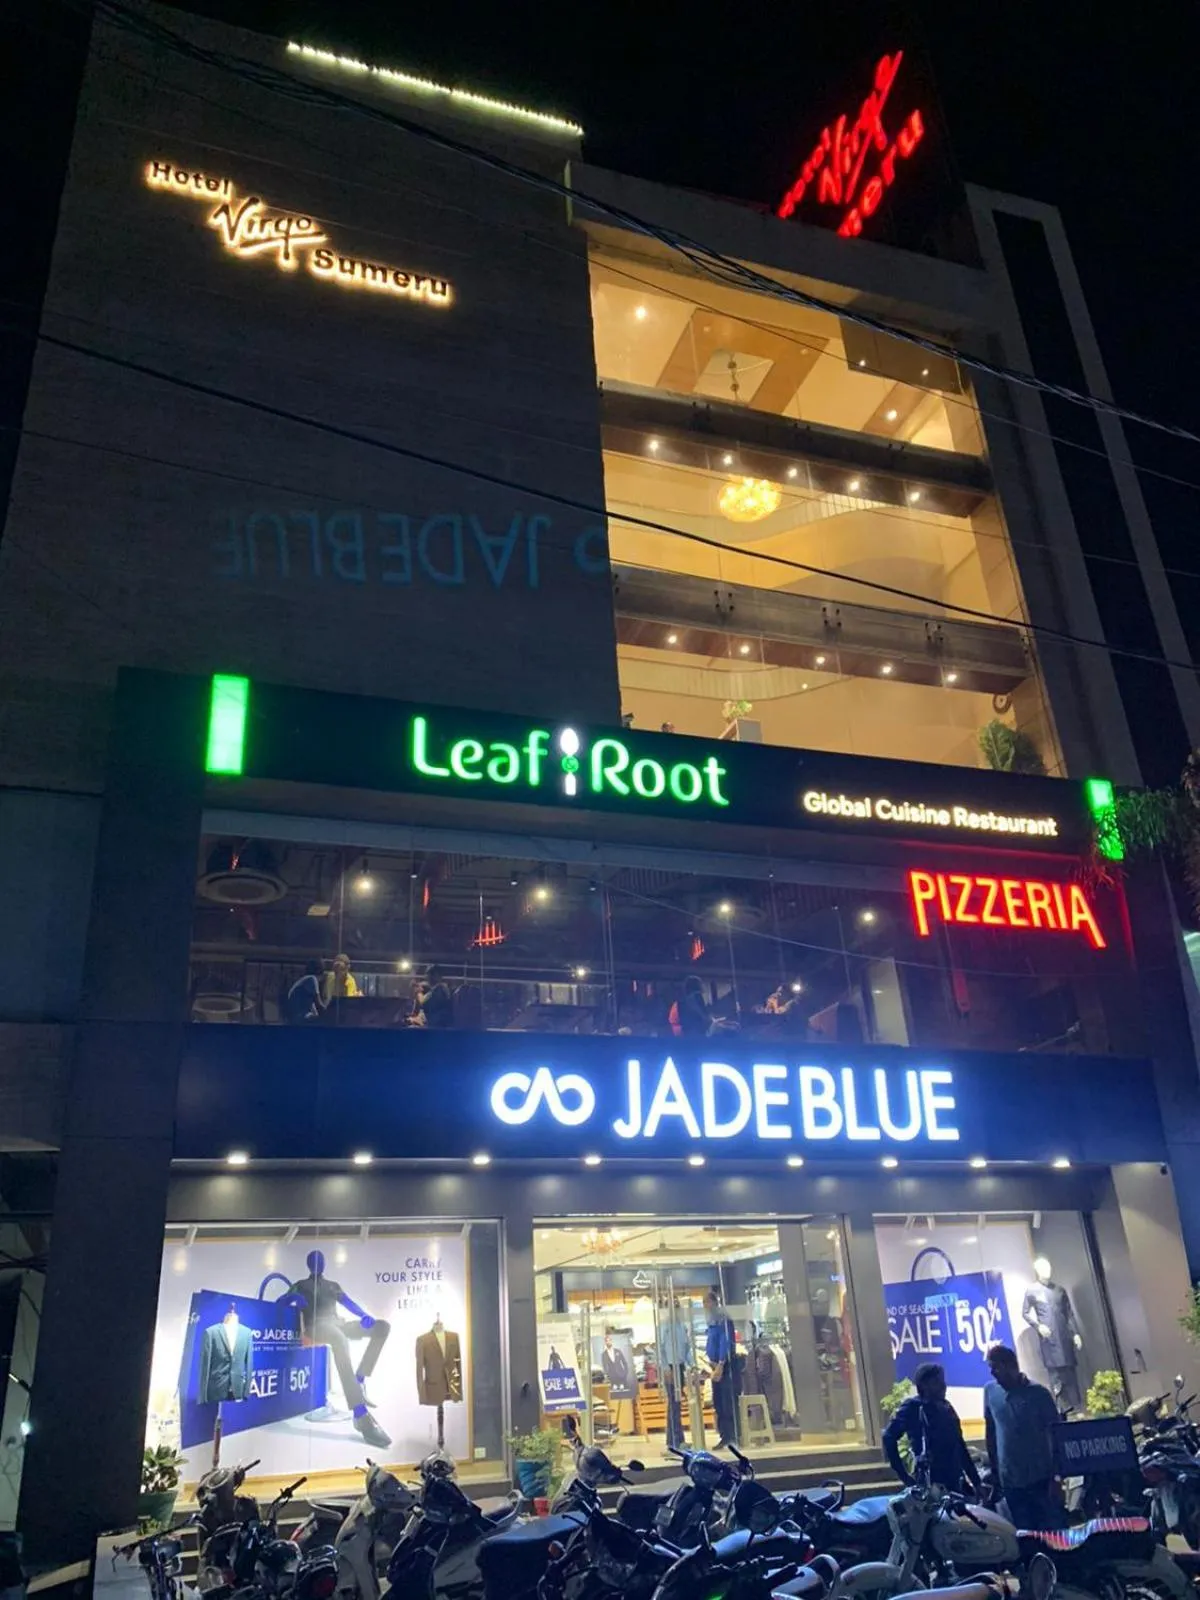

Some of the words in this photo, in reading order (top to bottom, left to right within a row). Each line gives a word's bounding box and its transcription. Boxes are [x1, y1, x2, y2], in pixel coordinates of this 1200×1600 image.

[148, 158, 231, 198] Hotel
[208, 195, 327, 265] Virgo
[312, 247, 450, 300] Sumeru
[411, 715, 551, 787] Leaf
[590, 737, 730, 806] Root
[803, 790, 872, 819] Global
[874, 798, 951, 826] Cuisine
[952, 805, 1059, 837] Restaurant
[909, 869, 1107, 949] PIZZERIA
[611, 1055, 961, 1142] JADEBLUE
[374, 1271, 407, 1283] YOUR
[411, 1270, 443, 1282] STYLE
[887, 1314, 943, 1357] SALE
[249, 1374, 278, 1398] ALE
[1064, 1440, 1081, 1459] NO
[1081, 1435, 1127, 1457] PARKING
